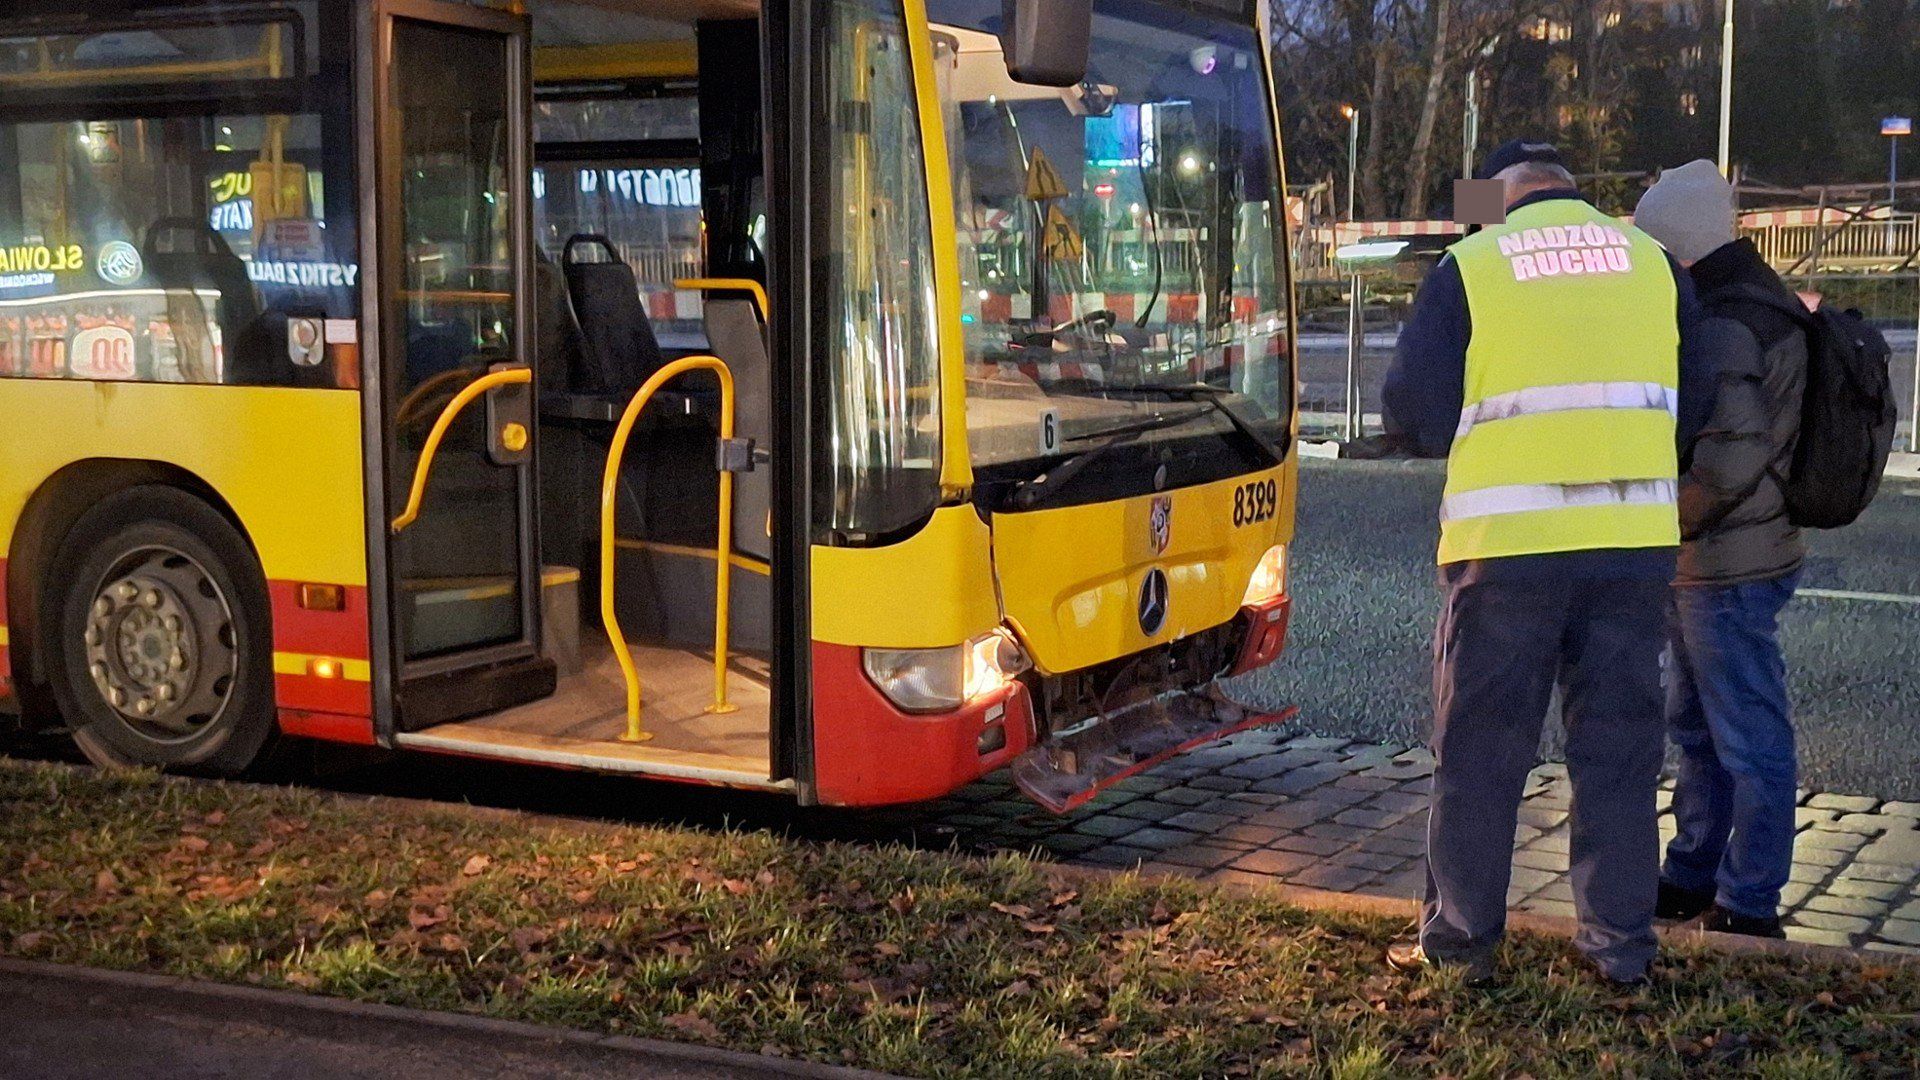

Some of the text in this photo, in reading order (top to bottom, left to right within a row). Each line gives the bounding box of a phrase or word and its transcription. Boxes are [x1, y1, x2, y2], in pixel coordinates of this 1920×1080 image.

[1497, 221, 1629, 256] NADZÓR
[1511, 247, 1630, 281] RUCHU
[1043, 412, 1055, 450] 6
[1233, 478, 1277, 528] 8329
